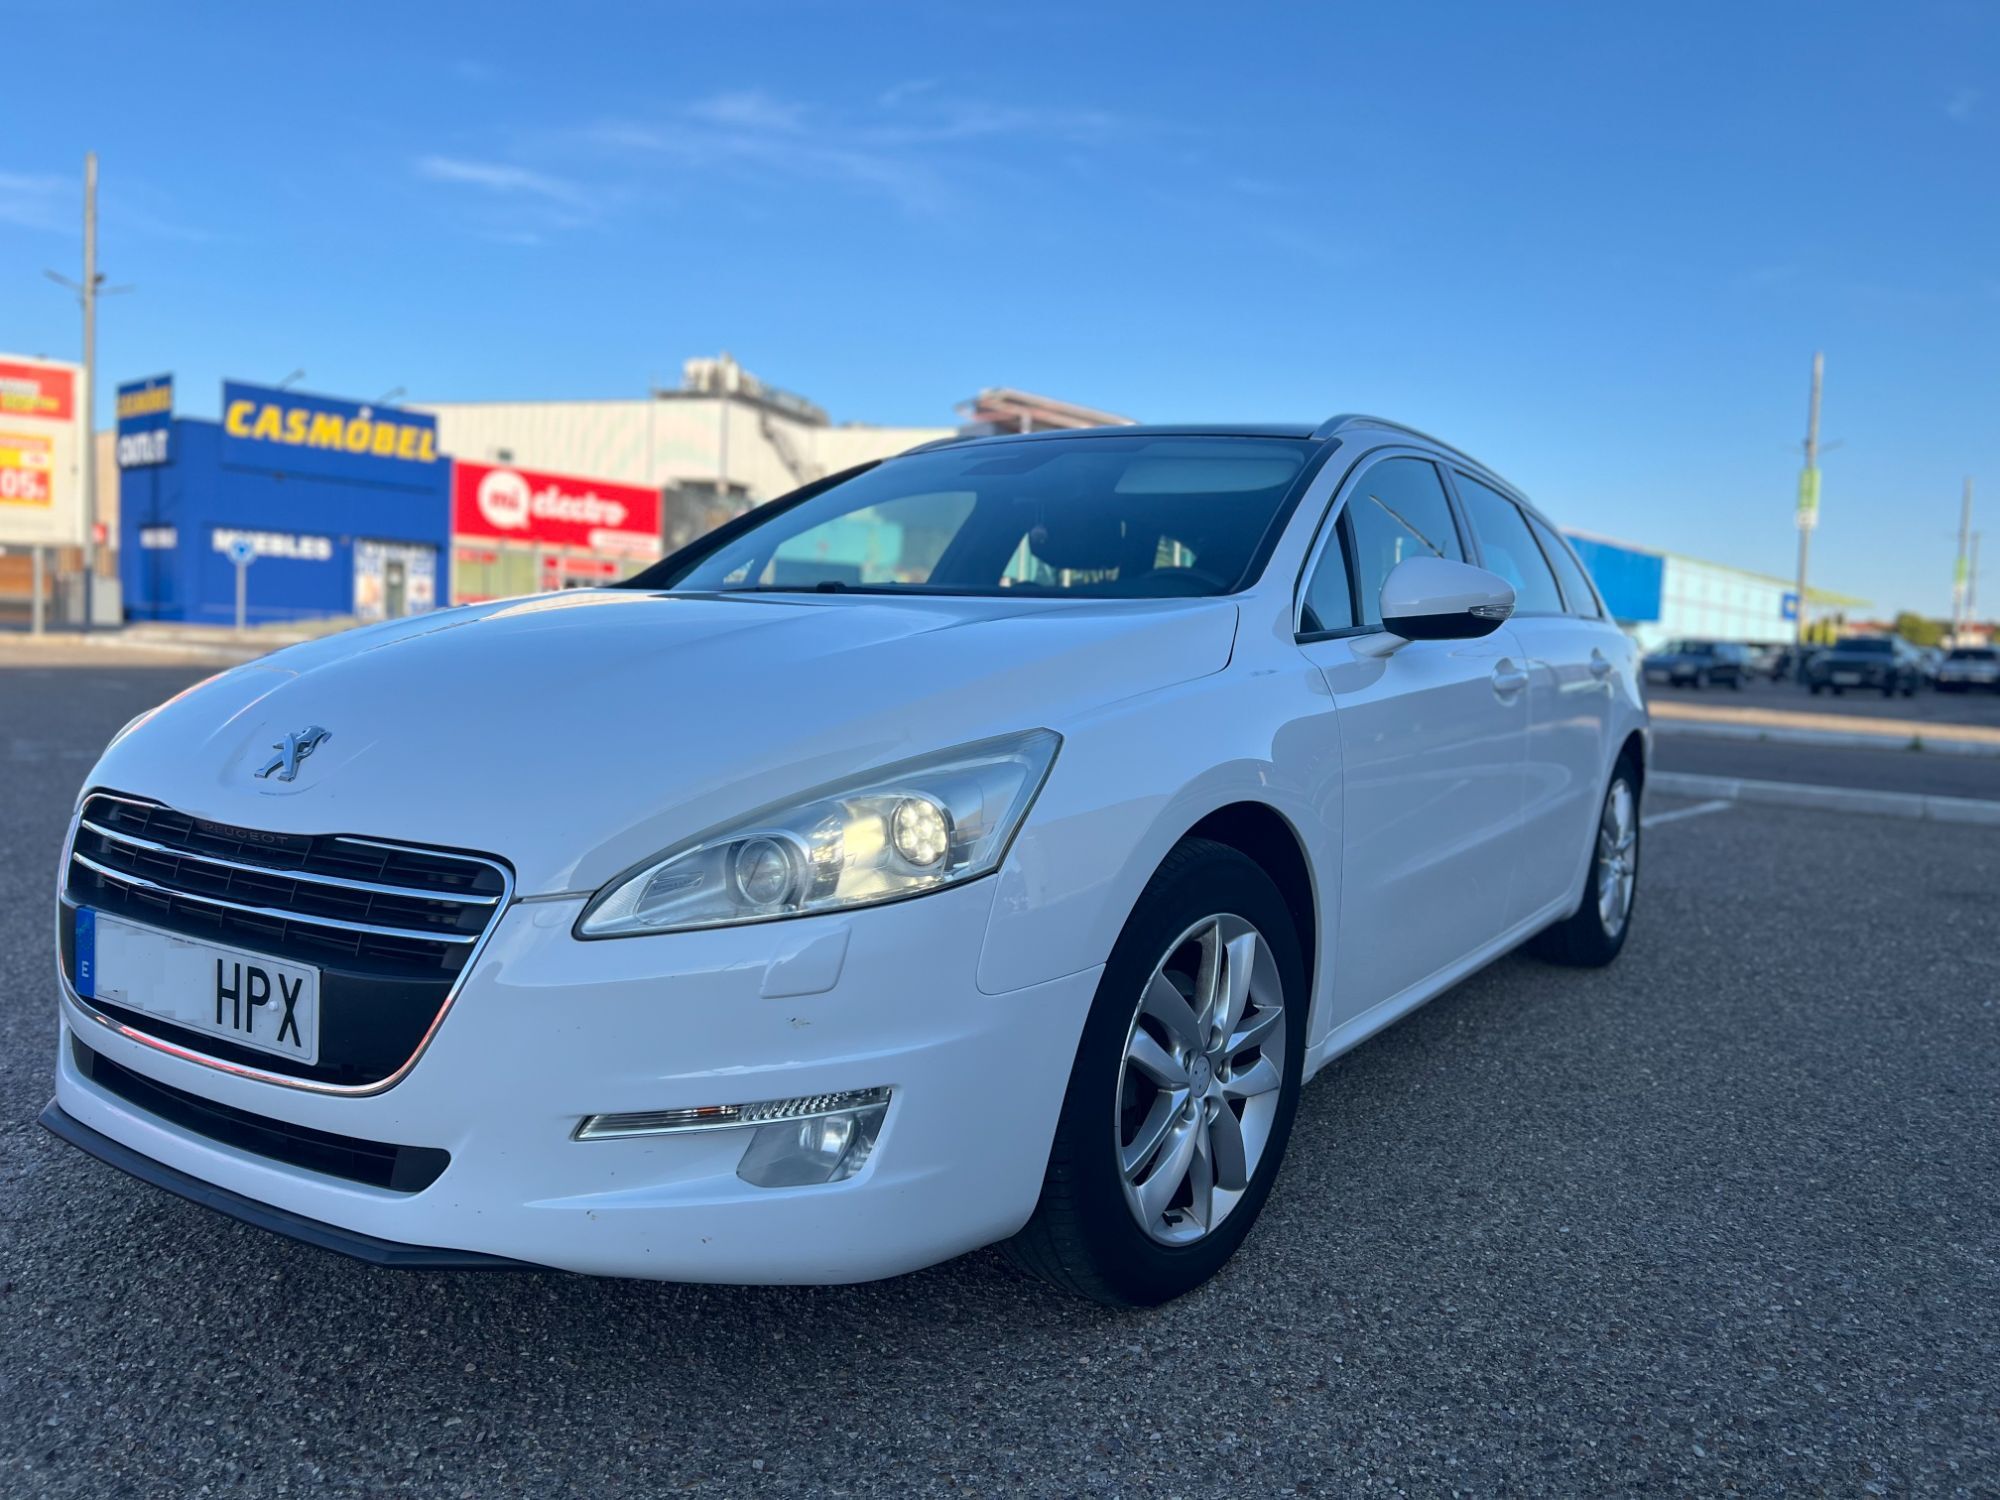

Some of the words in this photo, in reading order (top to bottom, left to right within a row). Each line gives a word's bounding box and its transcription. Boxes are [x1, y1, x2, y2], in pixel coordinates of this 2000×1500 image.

[204, 823, 289, 845] PEUGEOT
[81, 960, 90, 978] E
[216, 958, 303, 1048] HPX
